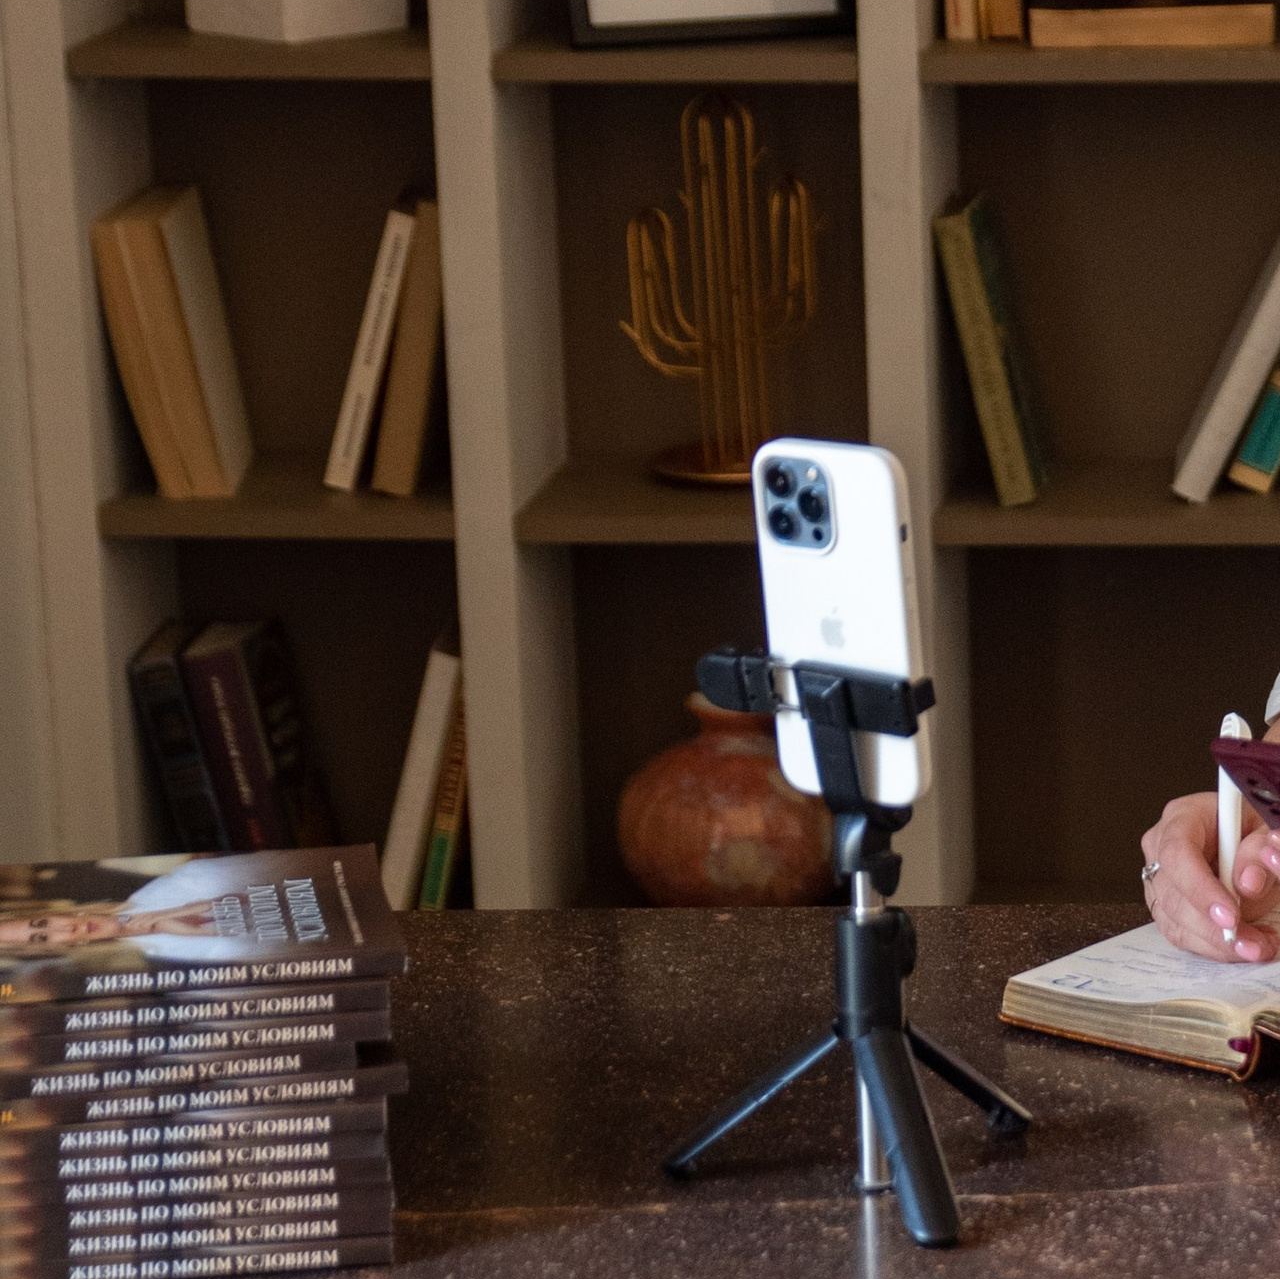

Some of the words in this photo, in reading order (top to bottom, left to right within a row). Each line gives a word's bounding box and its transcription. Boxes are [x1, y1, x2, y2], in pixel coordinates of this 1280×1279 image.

[86, 972, 154, 992] ЖИЗНЬ
[157, 969, 185, 987] ПО
[189, 964, 248, 984] МОИМ
[251, 956, 353, 979] УСЛОВИЯМ
[65, 1010, 134, 1030] ЖИЗНЬ
[137, 1007, 165, 1024] ПО
[169, 1002, 229, 1022] МОИМ
[231, 994, 334, 1017] УСЛОВИЯМ
[65, 1040, 134, 1060] ЖИЗНЬ
[137, 1037, 165, 1054] ПО
[169, 1032, 229, 1052] МОИМ
[231, 1024, 334, 1047] УСЛОВИЯМ
[31, 1073, 100, 1094] ЖИЗНЬ
[103, 1070, 131, 1088] ПО
[135, 1065, 194, 1085] МОИМ
[197, 1056, 300, 1080] УСЛОВИЯМ
[87, 1096, 155, 1118] ЖИЗНЬ
[158, 1093, 187, 1111] ПО
[190, 1087, 249, 1108] МОИМ
[252, 1078, 355, 1102] УСЛОВИЯМ
[60, 1129, 129, 1148] ЖИЗНЬ
[132, 1127, 160, 1144] ПО
[164, 1123, 224, 1142] МОИМ
[227, 1116, 331, 1138] УСЛОВИЯМ
[59, 1157, 128, 1178] ЖИЗНЬ
[131, 1155, 159, 1172] ПО
[163, 1150, 223, 1170] МОИМ
[226, 1142, 329, 1165] УСЛОВИЯМ
[65, 1182, 134, 1202] ЖИЗНЬ
[137, 1180, 166, 1197] ПО
[169, 1176, 229, 1195] МОИМ
[232, 1168, 335, 1190] УСЛОВИЯМ
[70, 1208, 139, 1228] ЖИЗНЬ
[142, 1205, 170, 1223] ПО
[174, 1201, 233, 1220] МОИМ
[236, 1192, 339, 1215] УСЛОВИЯМ
[69, 1234, 138, 1254] ЖИЗНЬ
[141, 1231, 169, 1249] ПО
[173, 1227, 232, 1246] МОИМ
[235, 1219, 338, 1241] УСЛОВИЯМ
[141, 1262, 169, 1279] ПО
[173, 1257, 232, 1276] МОИМ
[235, 1249, 338, 1272] УСЛОВИЯМ
